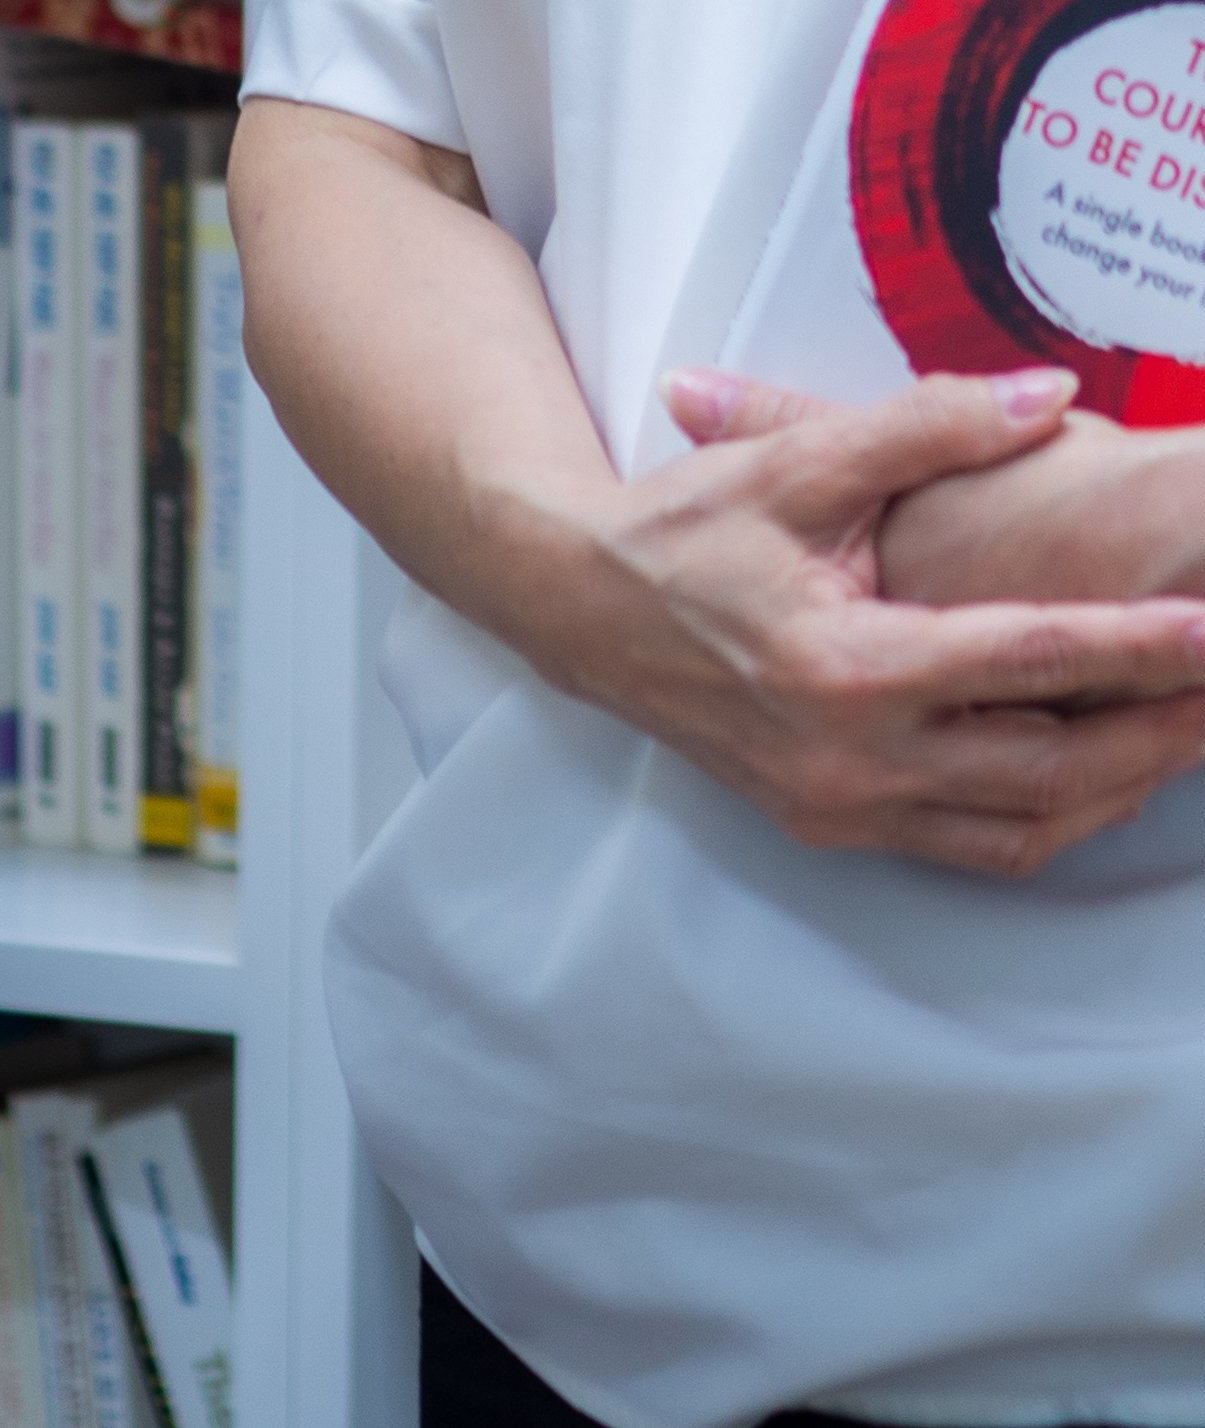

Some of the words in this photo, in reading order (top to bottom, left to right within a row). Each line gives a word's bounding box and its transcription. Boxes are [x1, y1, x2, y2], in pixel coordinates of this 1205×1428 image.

[1021, 98, 1078, 150] TO
[1088, 128, 1144, 178] BE
[1044, 181, 1065, 209] A
[1073, 194, 1144, 236] single
[1041, 221, 1132, 277] change
[1134, 265, 1196, 300] your
